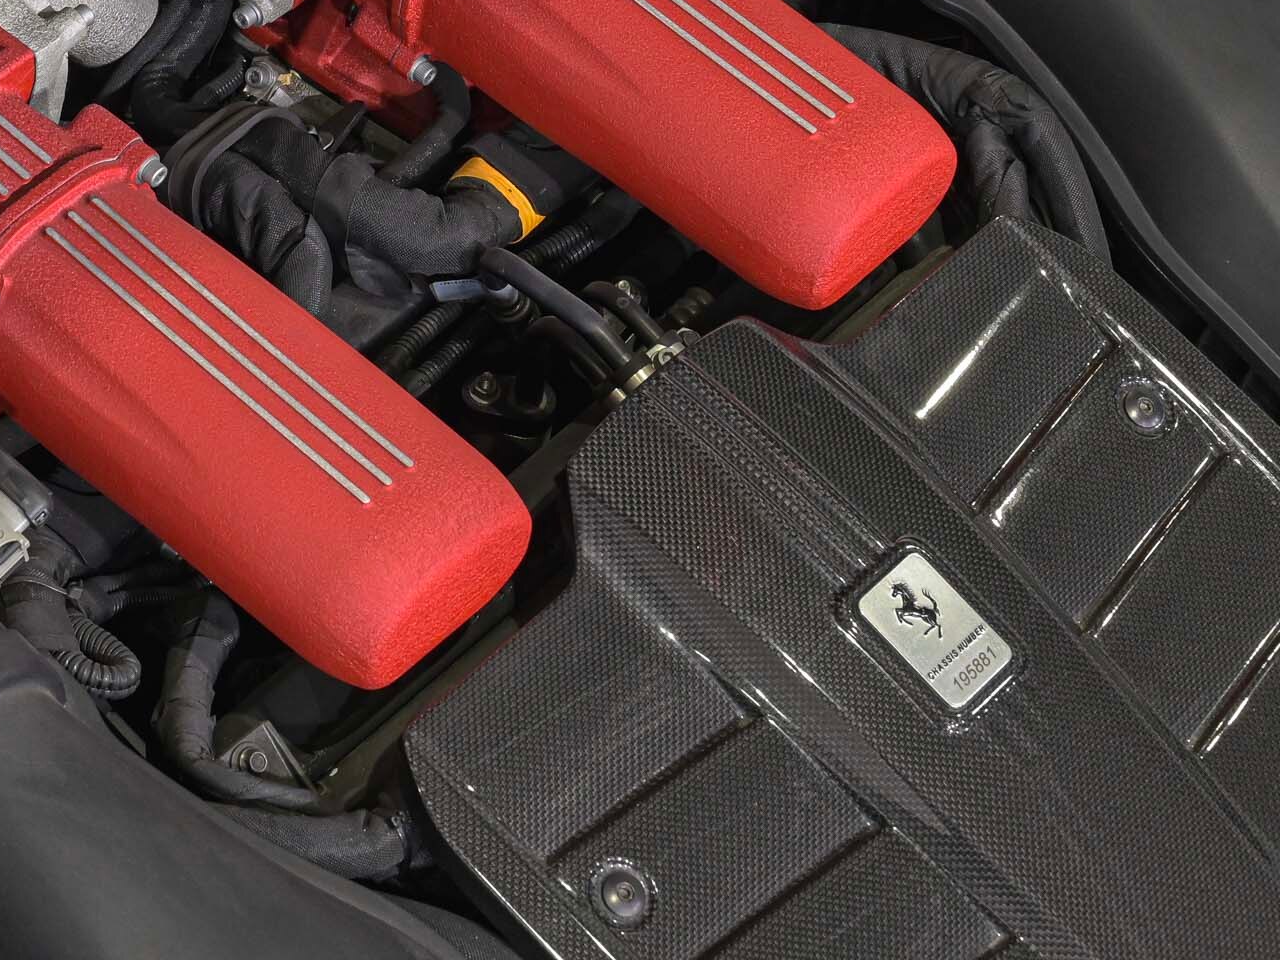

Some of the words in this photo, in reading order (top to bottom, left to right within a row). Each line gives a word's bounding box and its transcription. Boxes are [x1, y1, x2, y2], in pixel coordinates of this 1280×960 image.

[927, 648, 960, 682] CHASSIS
[958, 624, 986, 652] NUMBER
[953, 645, 997, 692] 195881
